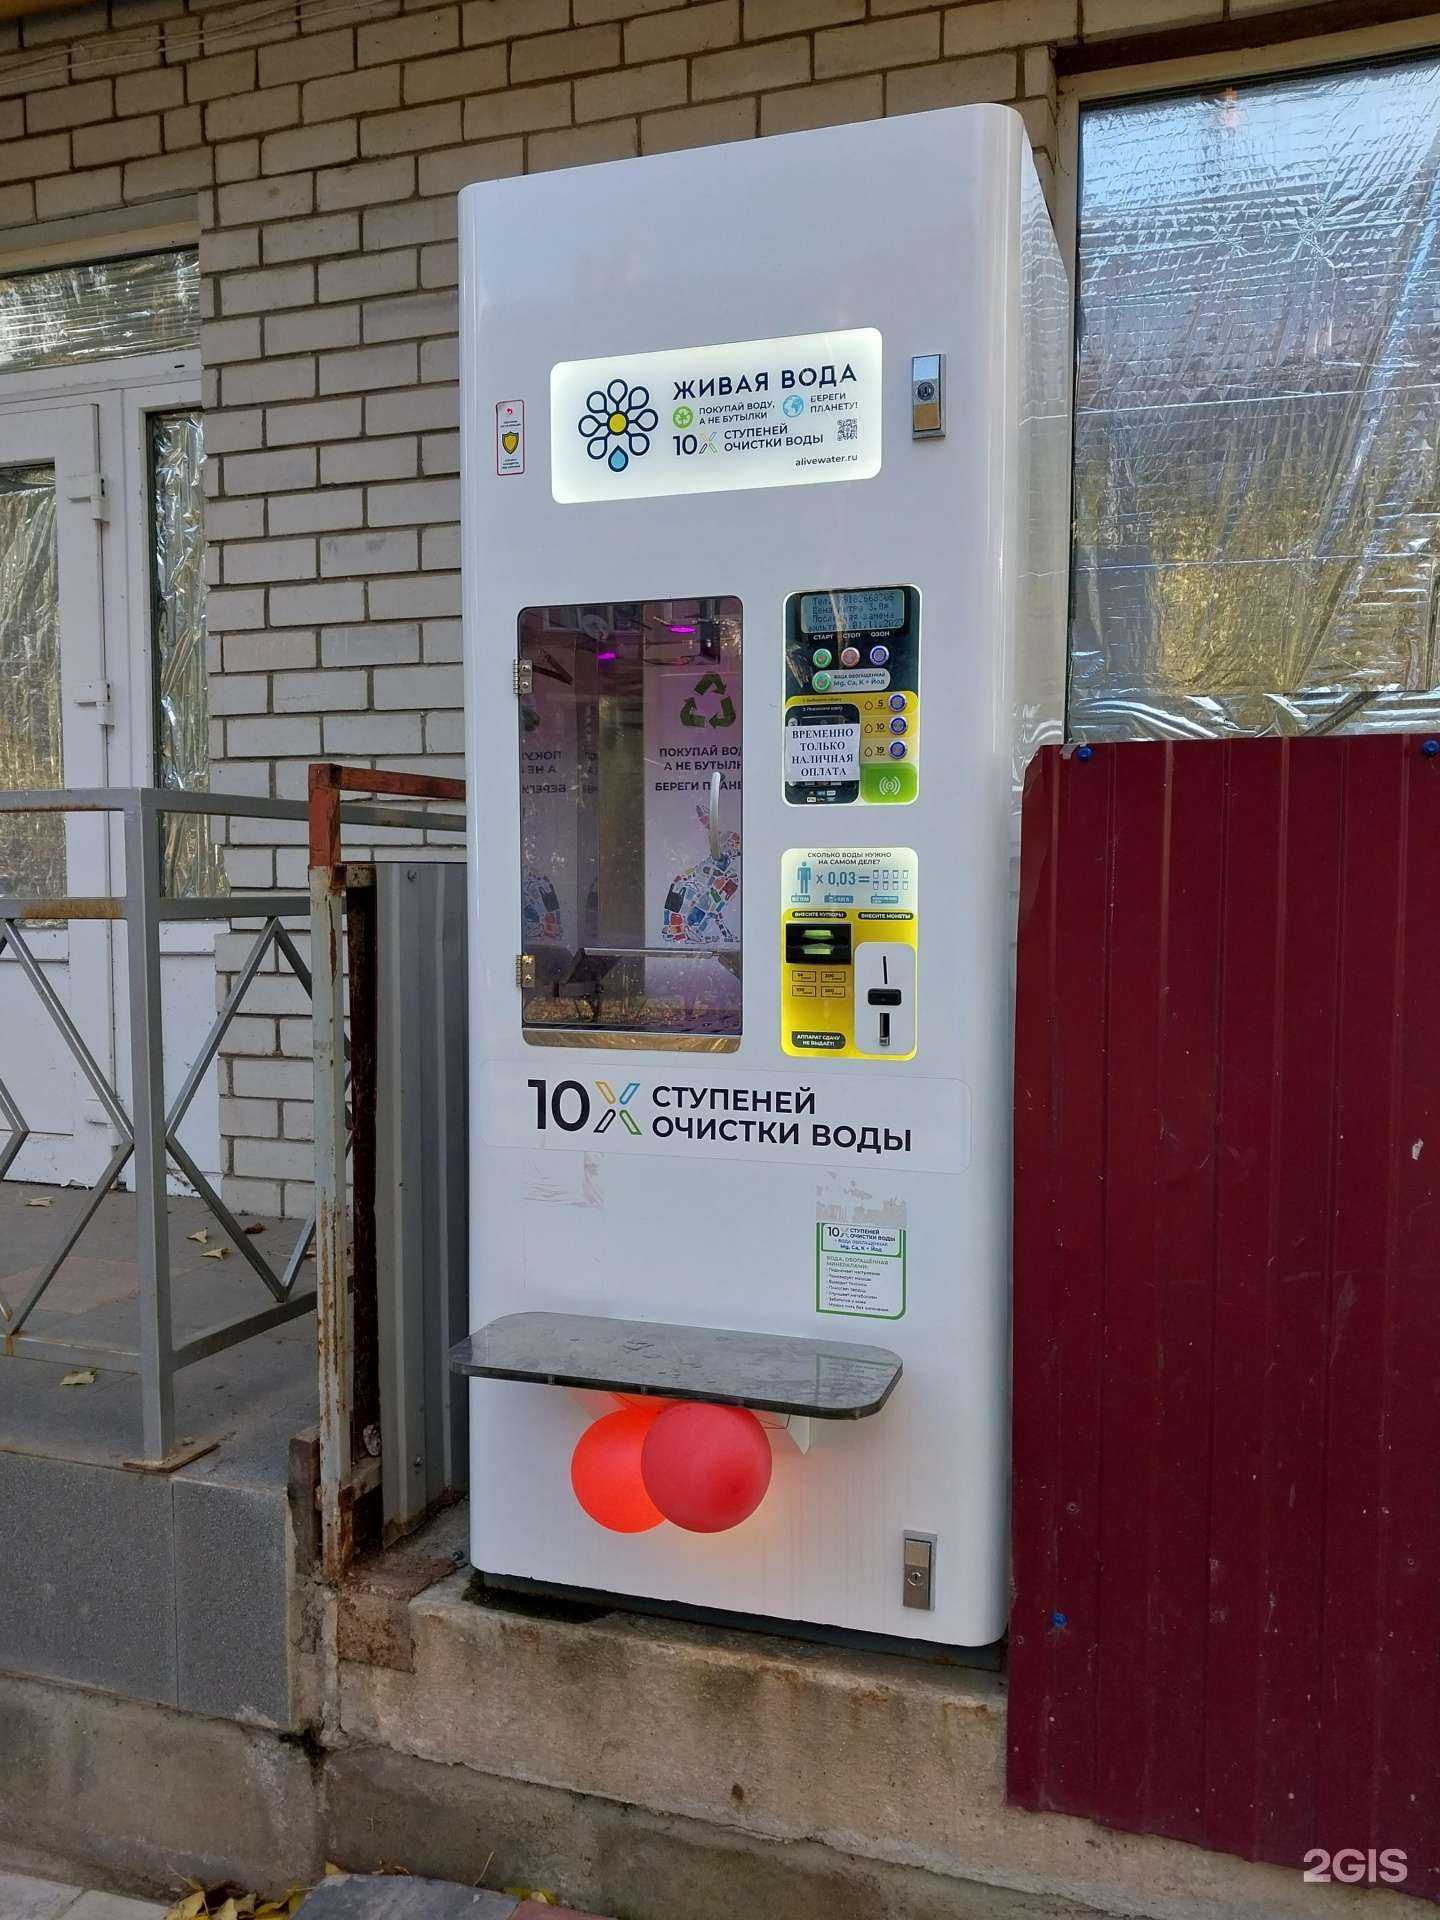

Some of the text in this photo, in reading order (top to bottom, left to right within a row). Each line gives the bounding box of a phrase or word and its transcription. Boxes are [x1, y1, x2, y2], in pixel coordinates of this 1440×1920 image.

[673, 363, 857, 400] ЖИВАЯ ВОДА
[810, 392, 847, 403] БЕРЕГИ
[699, 400, 775, 415] ПОКУПАЙ ВОДУ,
[810, 402, 859, 413] ПЛАНЕТУ!
[708, 416, 720, 424] НЕ
[722, 412, 768, 423] БУТЫЛКИ
[724, 423, 788, 440] СТУПЕНЕЙ
[724, 434, 824, 452] ОЧИСТКИ ВОДЫ
[795, 454, 858, 467] alivewater.ru
[876, 722, 885, 730] 10
[792, 729, 854, 739] ВРЕМЕННО
[659, 745, 718, 757] ПОКУПАЙ
[800, 741, 845, 751] ТОЛЬКО
[792, 754, 853, 764] НАЛИЧНАЯ
[664, 762, 672, 770] А
[675, 761, 691, 770] НЕ
[801, 767, 847, 776] ОПЛАТА
[655, 780, 742, 791] БЕРЕГИ ПАНЕ
[828, 871, 856, 887] 0,03
[652, 1085, 815, 1115] СТУПЕНЕЙ
[652, 1115, 911, 1154] ОЧИСТКИ ВОДЫ
